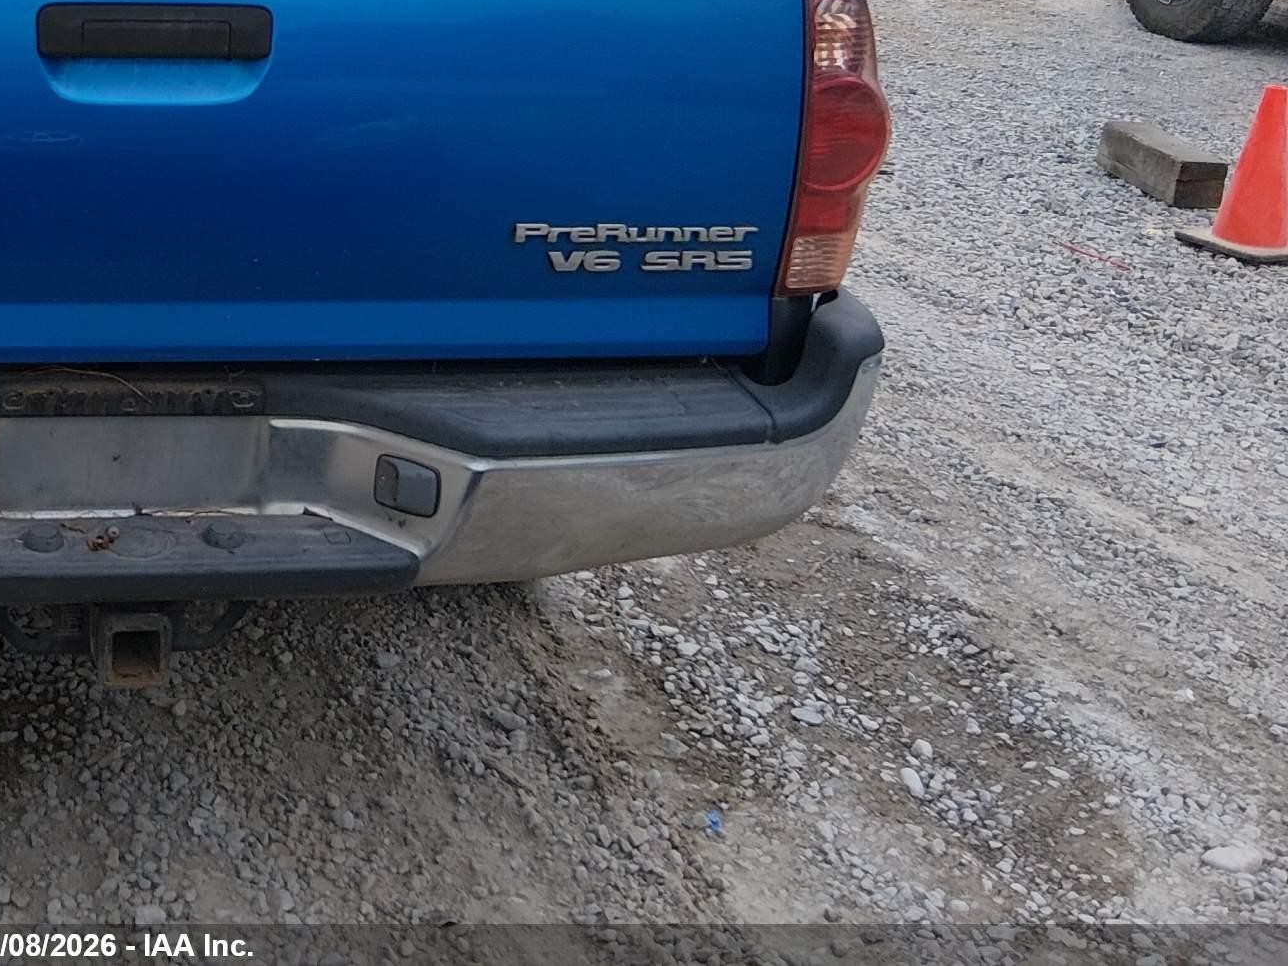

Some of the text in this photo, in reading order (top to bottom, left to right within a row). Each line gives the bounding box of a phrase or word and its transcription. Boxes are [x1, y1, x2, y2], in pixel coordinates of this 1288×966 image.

[515, 223, 759, 243] PreRunner
[548, 250, 753, 272] V6 SR5
